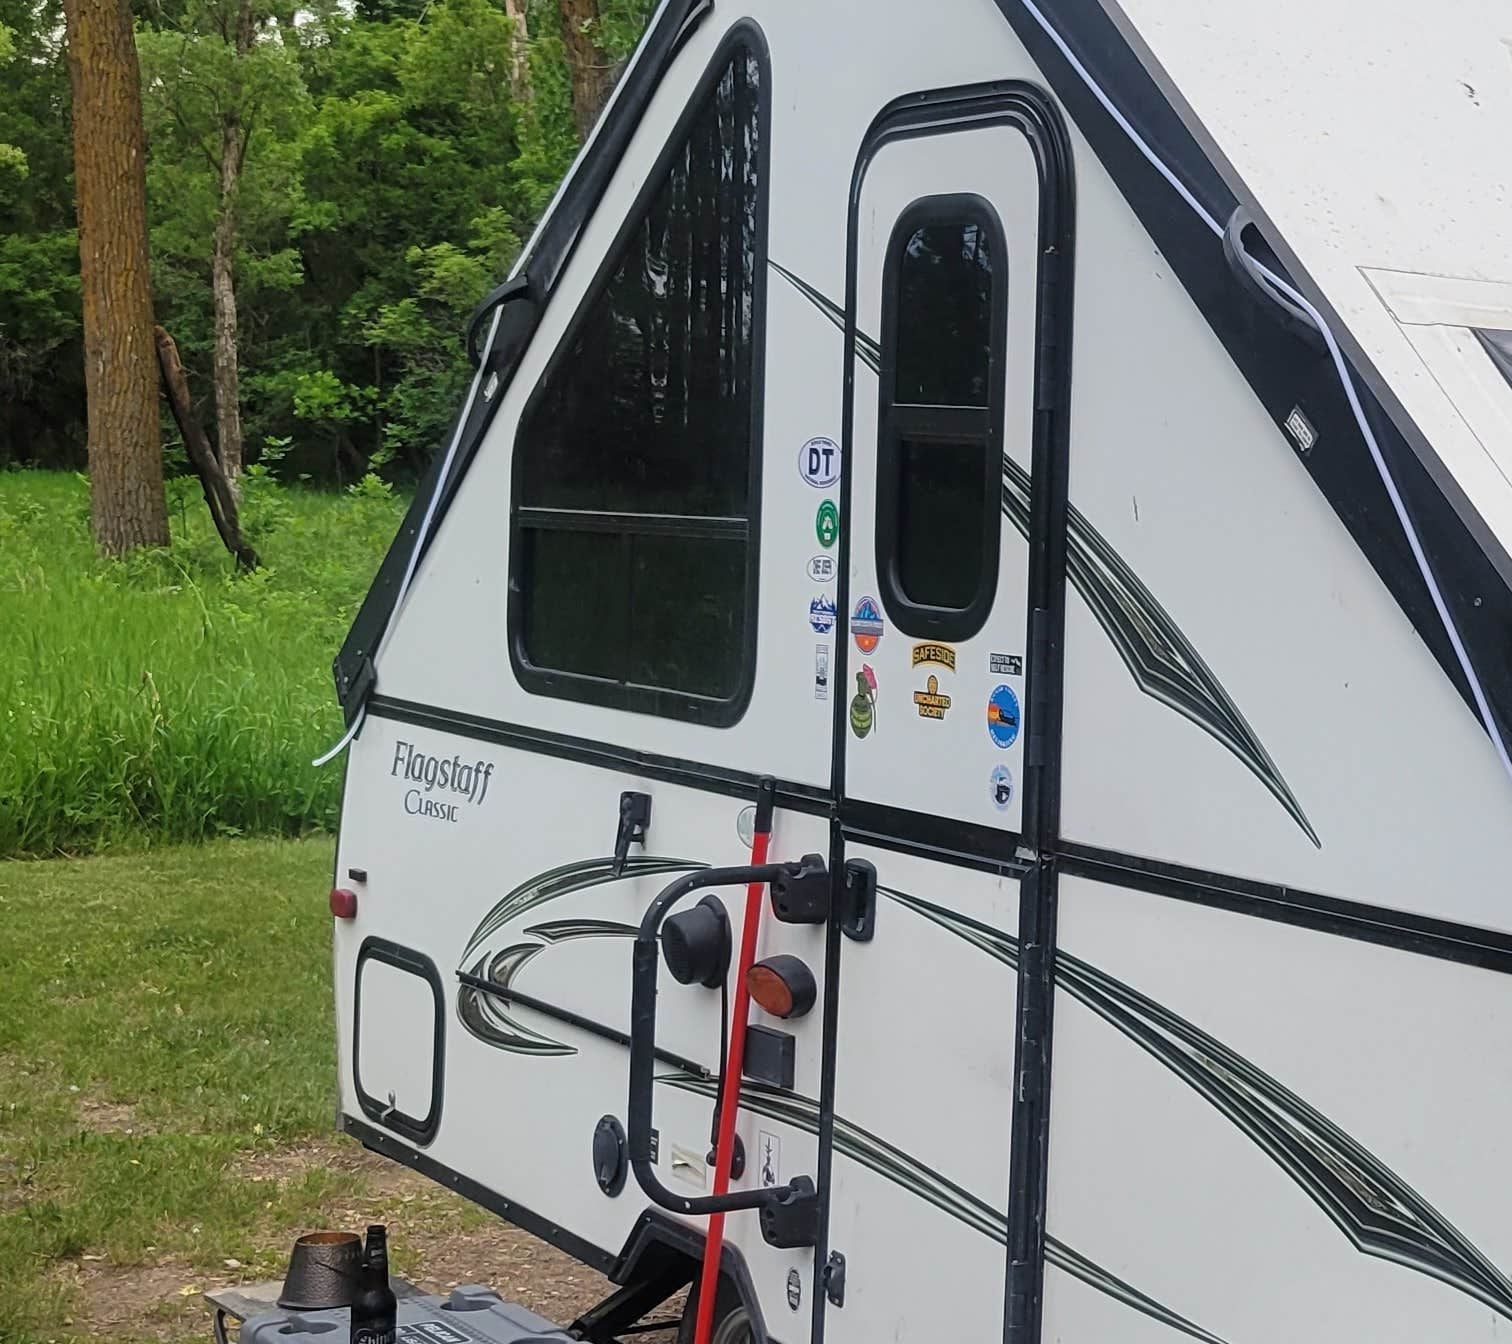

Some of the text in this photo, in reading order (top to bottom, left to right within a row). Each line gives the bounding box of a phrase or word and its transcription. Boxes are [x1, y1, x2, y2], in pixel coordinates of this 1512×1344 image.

[808, 447, 834, 477] DT
[912, 645, 955, 667] SAFESIDE
[391, 741, 495, 805] Flagstaff
